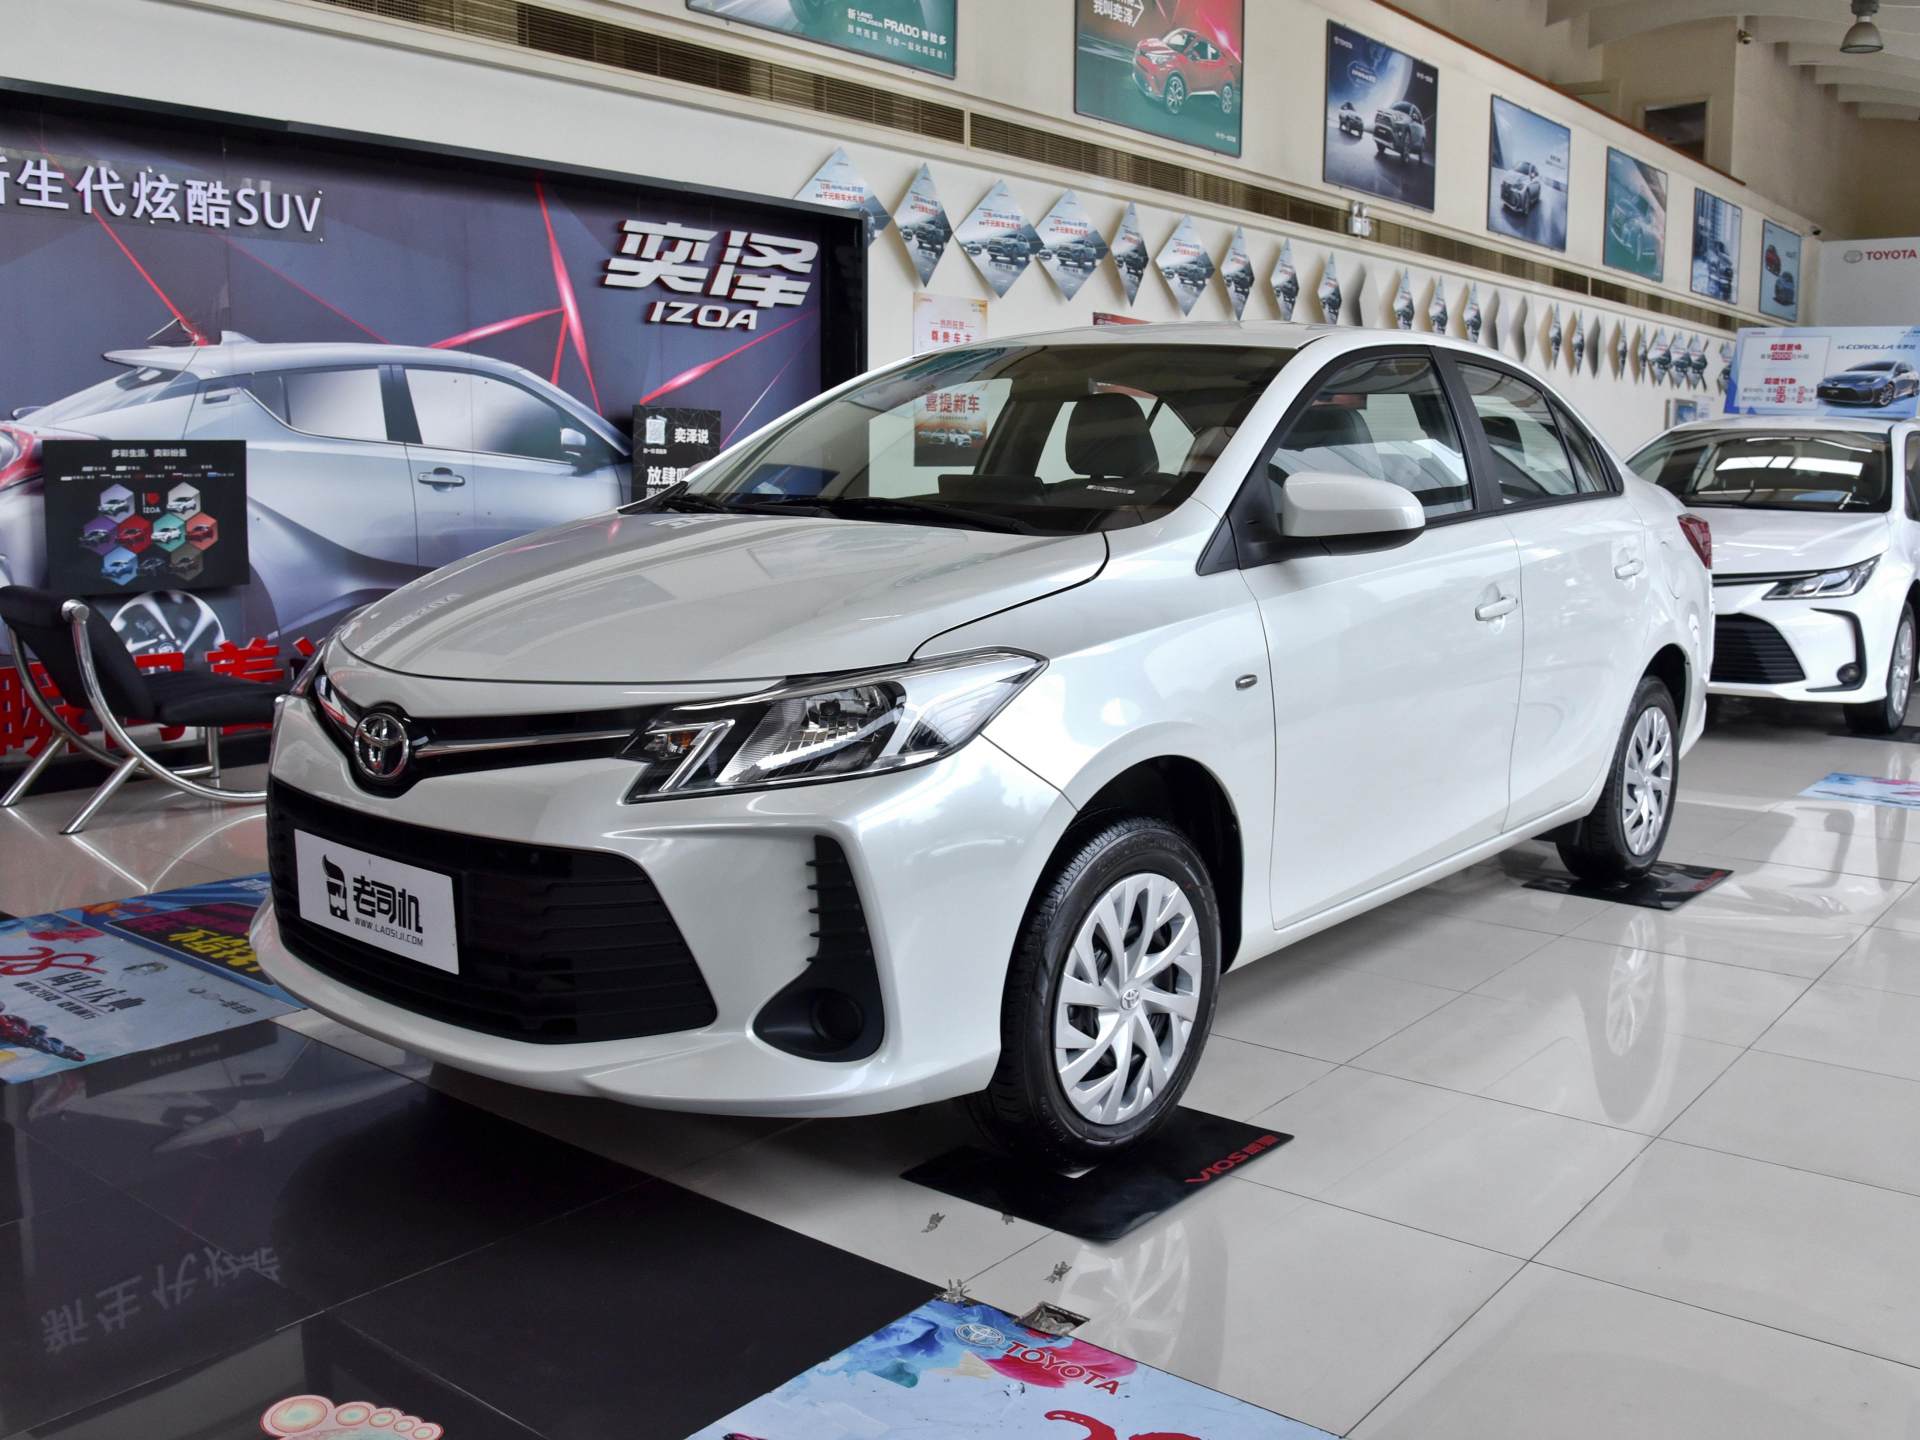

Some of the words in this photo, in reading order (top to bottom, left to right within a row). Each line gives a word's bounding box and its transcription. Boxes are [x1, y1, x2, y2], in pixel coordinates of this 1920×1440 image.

[883, 18, 920, 38] PRADO
[0, 154, 321, 233] 生代炫酷SUV
[600, 219, 819, 308] 奕泽
[1865, 249, 1918, 261] TOYOTA
[647, 301, 758, 330] IZOA
[674, 428, 709, 444] 奕泽说
[353, 875, 424, 934] 老司机
[354, 917, 424, 947] WWW.LAOSIJI.COM
[1184, 1151, 1248, 1184] VIOS
[1005, 1341, 1120, 1395] TOYOTA
